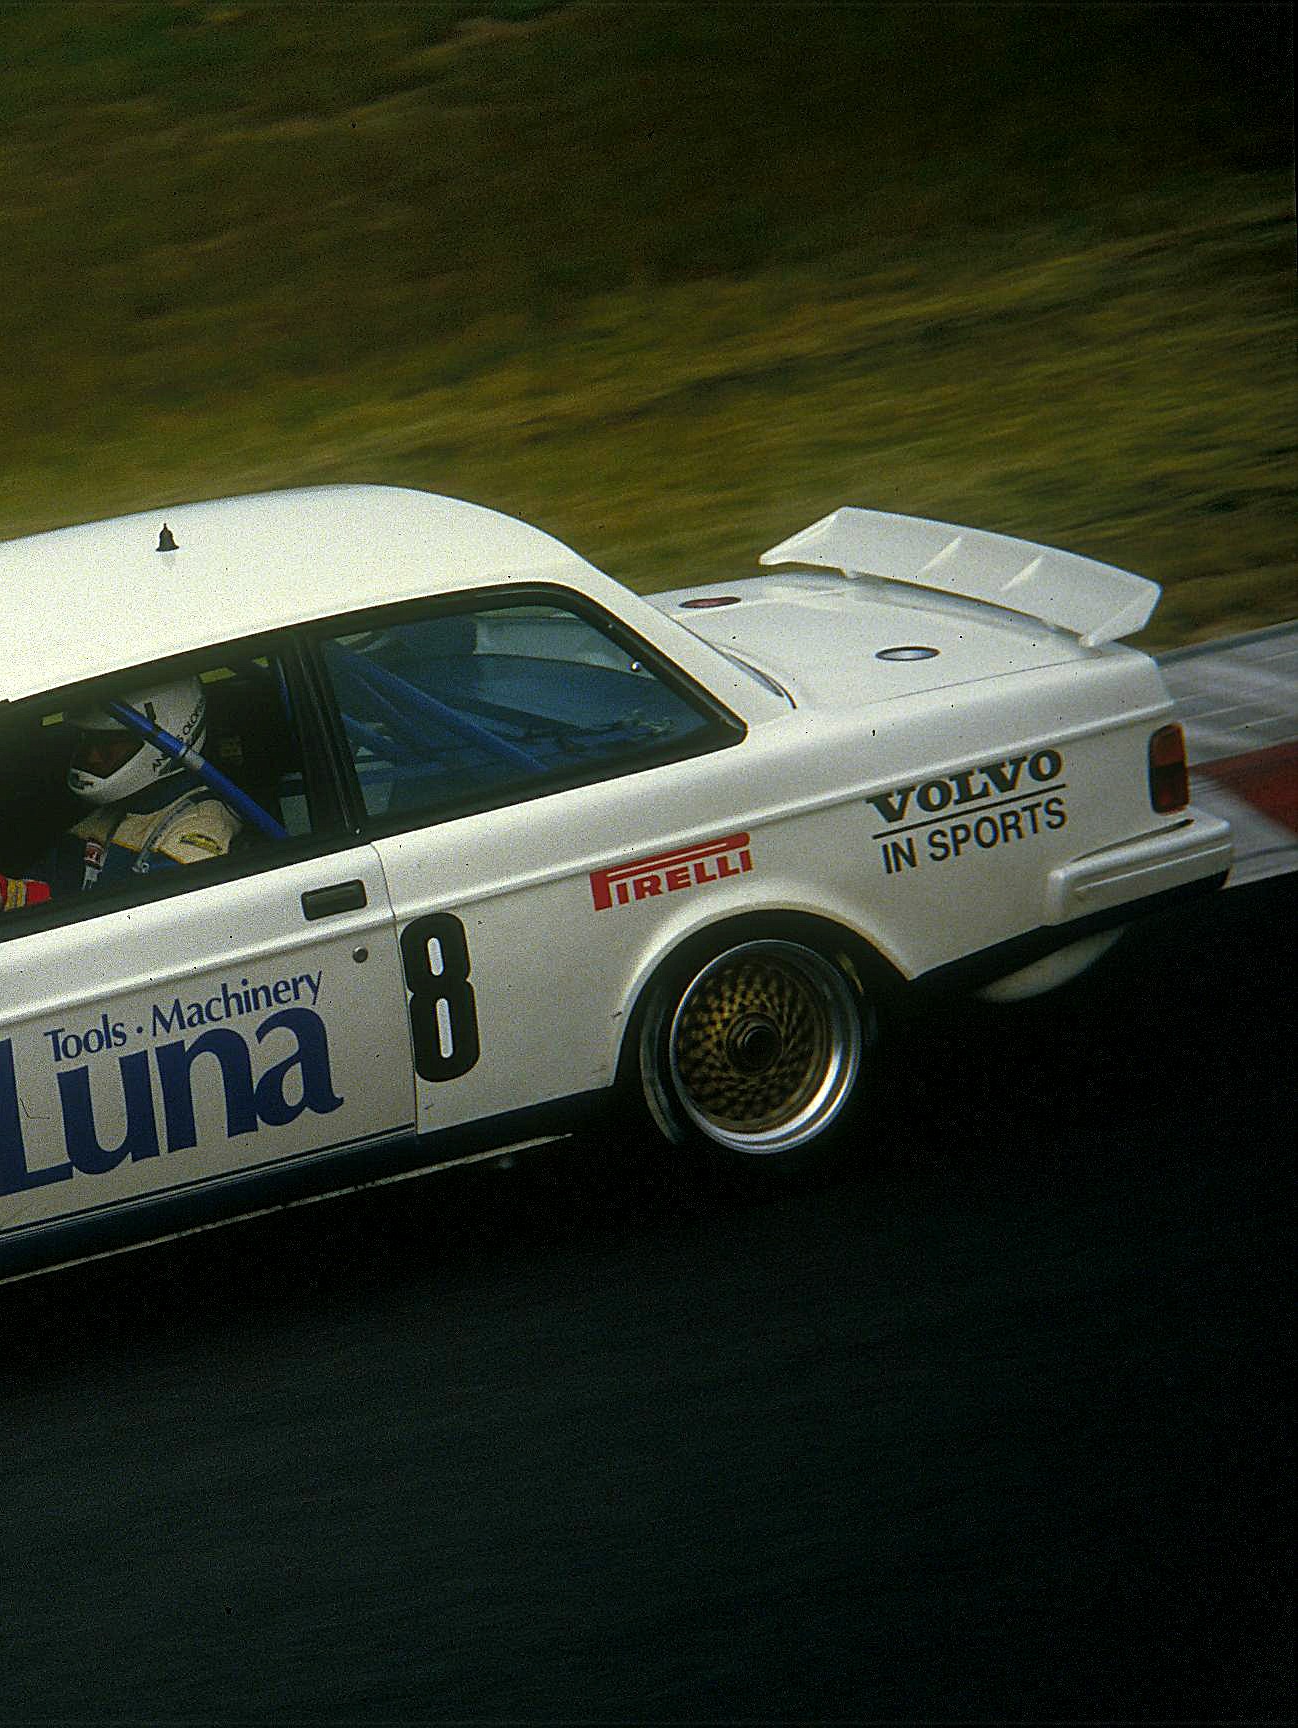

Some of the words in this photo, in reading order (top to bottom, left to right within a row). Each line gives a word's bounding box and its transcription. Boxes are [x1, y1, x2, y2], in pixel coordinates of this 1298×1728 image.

[866, 750, 1063, 823] VOLVO
[589, 831, 754, 912] PIRELLI
[881, 837, 917, 874] IN
[928, 797, 1068, 861] SPORTS
[44, 1015, 128, 1062] Tools
[151, 970, 323, 1037] Machinery
[401, 912, 480, 1082] 8
